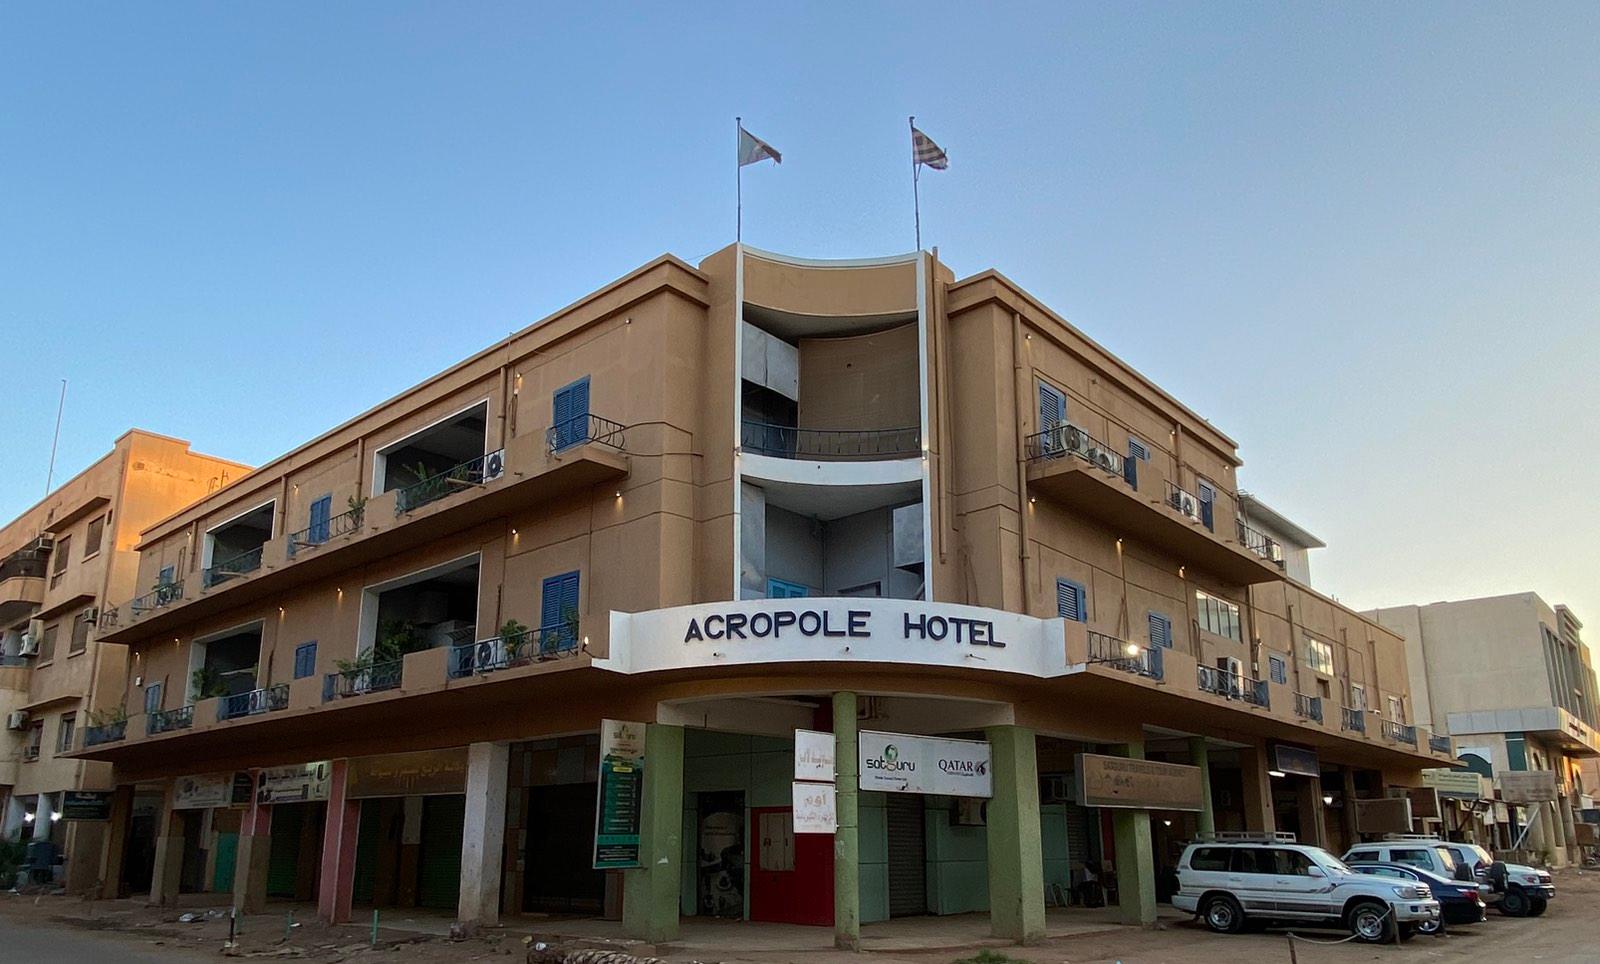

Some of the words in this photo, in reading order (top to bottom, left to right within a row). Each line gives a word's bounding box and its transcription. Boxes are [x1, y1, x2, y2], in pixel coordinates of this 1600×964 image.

[684, 610, 872, 643] ACROPOLE
[903, 612, 1007, 648] HOTEL
[938, 759, 973, 773] QATAR
